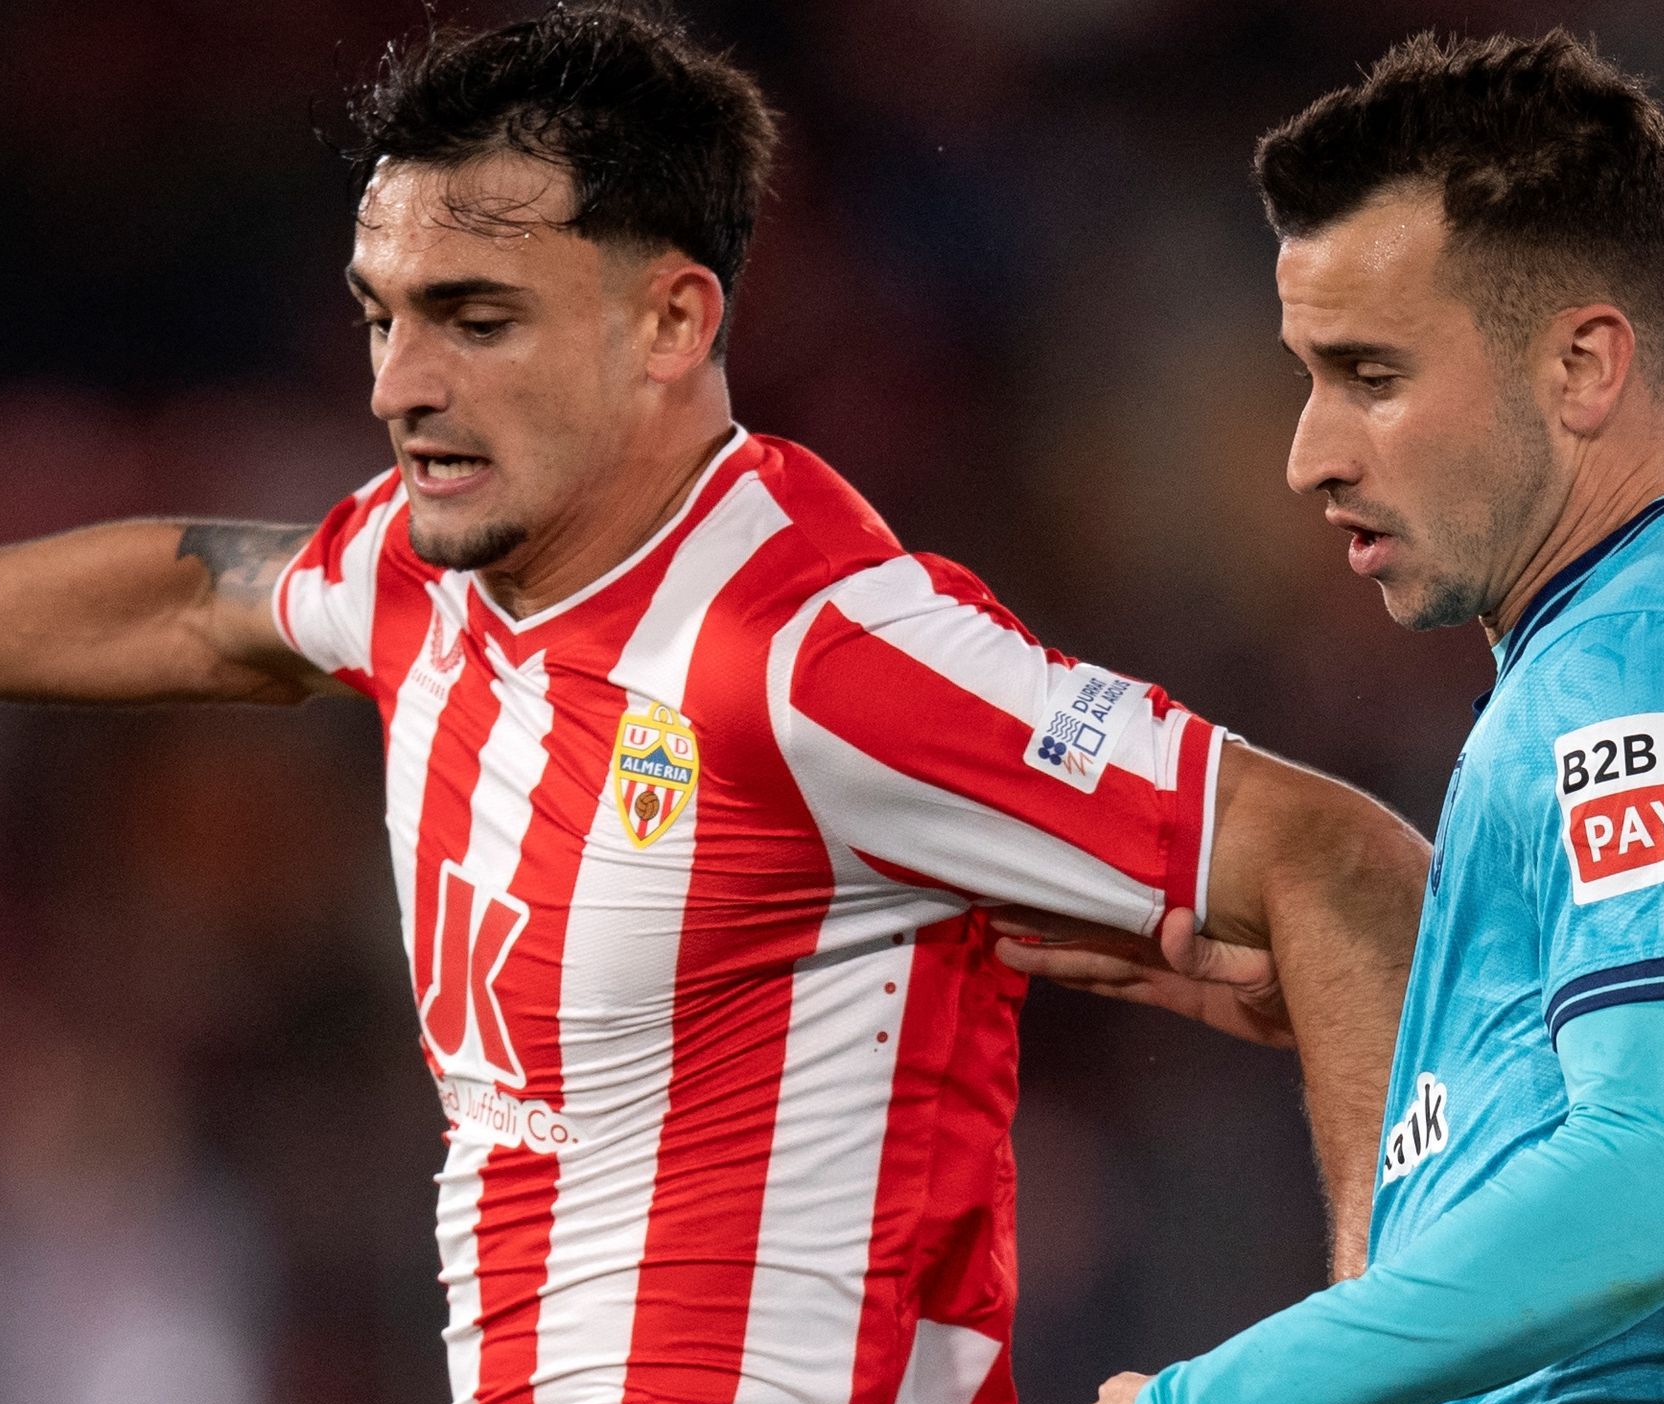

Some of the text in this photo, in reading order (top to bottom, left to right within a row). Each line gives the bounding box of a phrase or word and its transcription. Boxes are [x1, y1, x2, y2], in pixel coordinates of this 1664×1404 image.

[1072, 677, 1107, 714] DURRAT
[622, 756, 689, 782] ALMERIA
[528, 1110, 579, 1144] Co.
